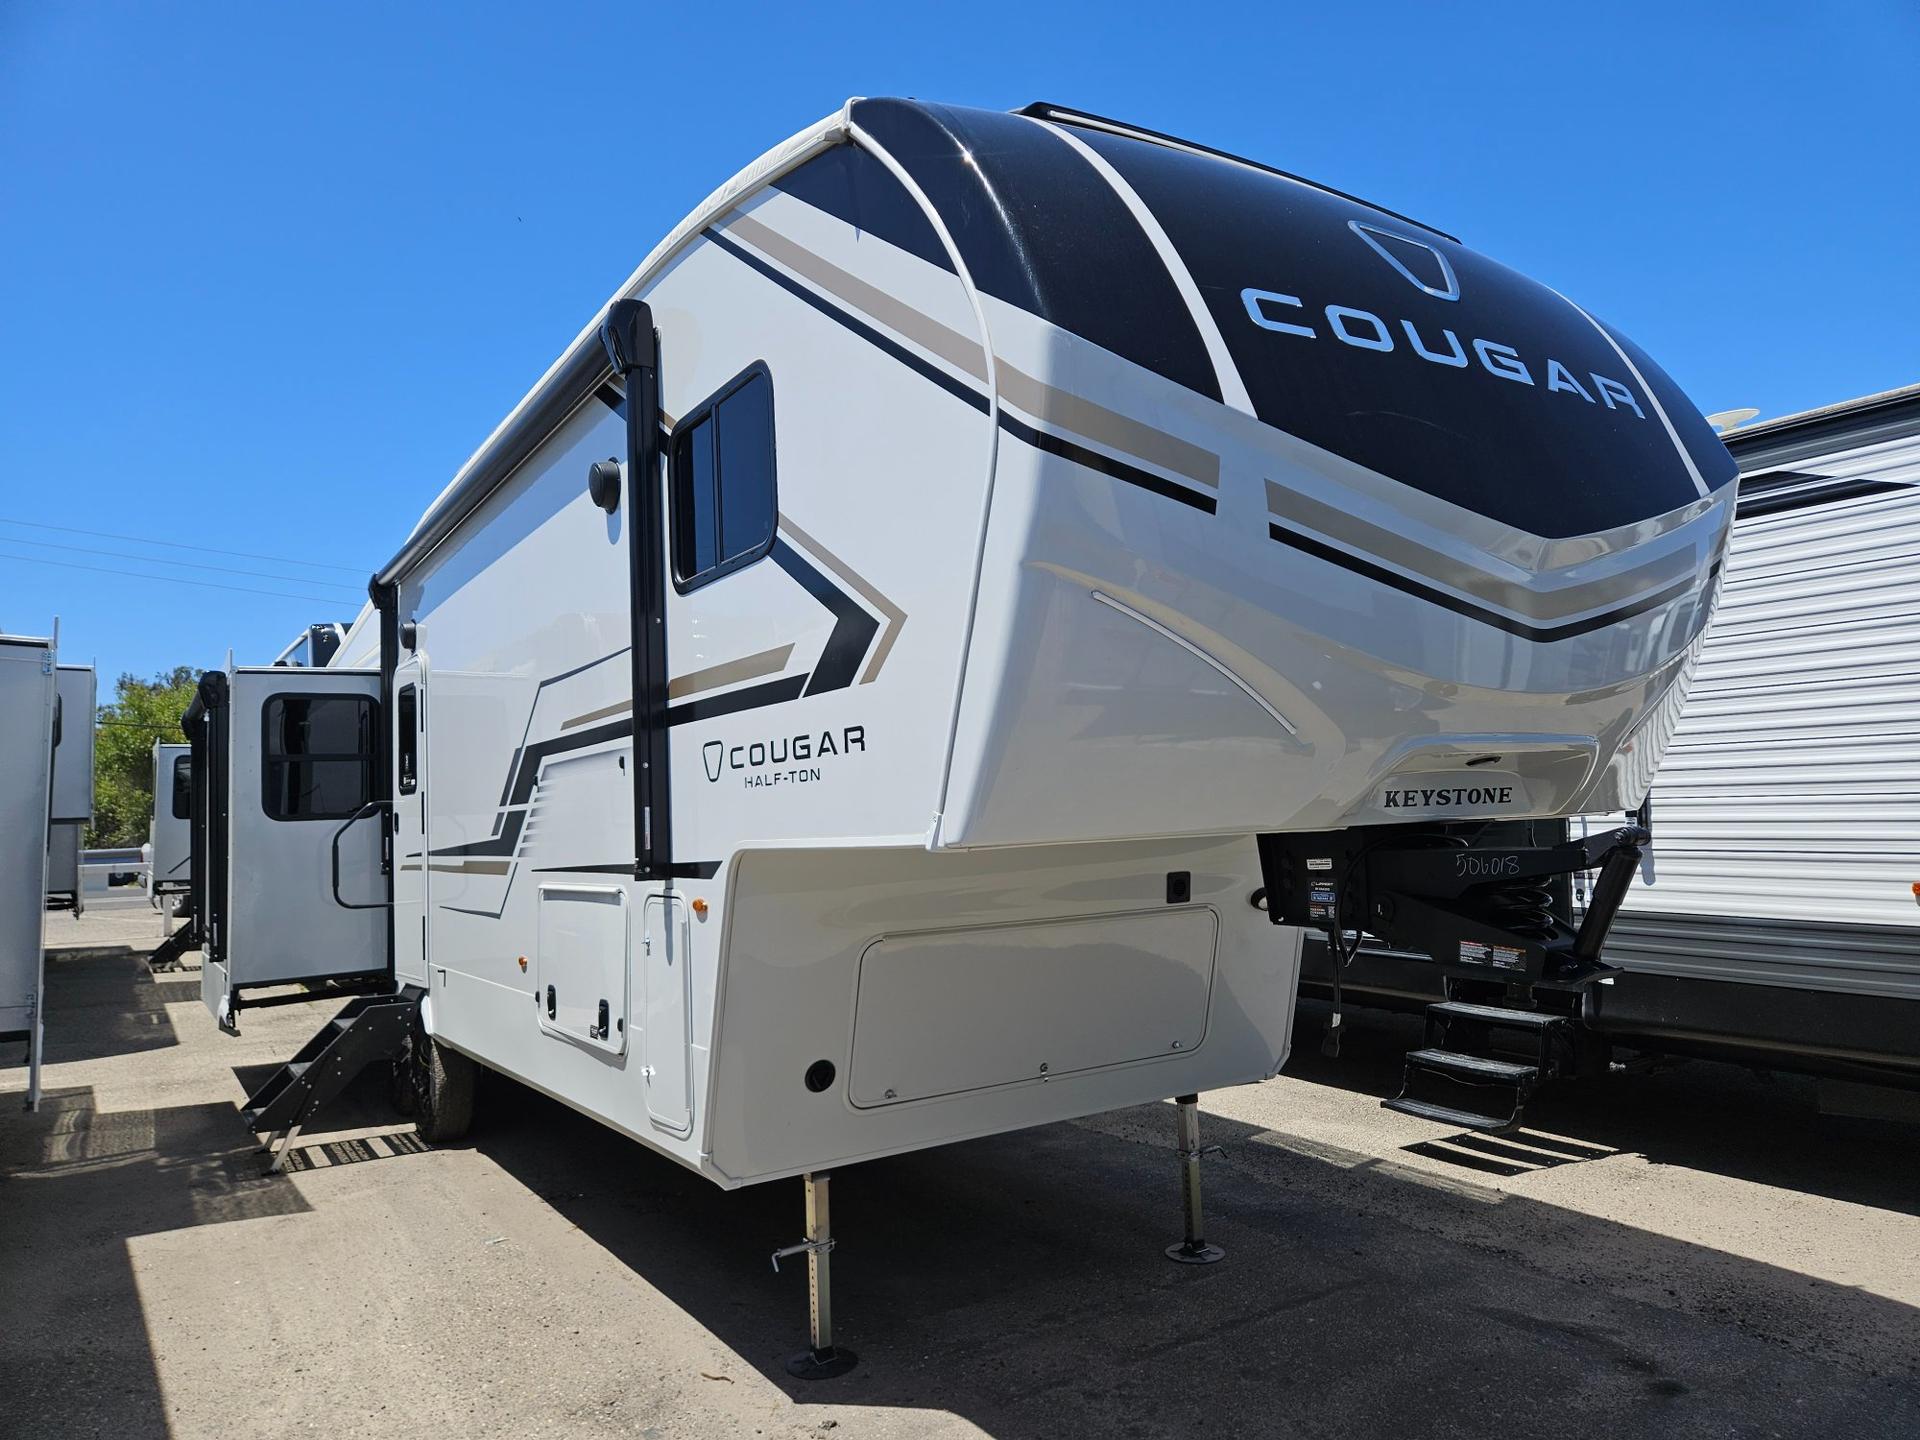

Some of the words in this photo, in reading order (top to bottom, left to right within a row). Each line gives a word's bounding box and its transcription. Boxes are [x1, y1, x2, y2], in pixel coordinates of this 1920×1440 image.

[1240, 287, 1646, 420] COUGAR
[730, 725, 866, 769] COUGAR
[744, 768, 821, 788] HALF-TON
[1384, 786, 1513, 808] KEYSTONE
[1456, 853, 1520, 877] 506018
